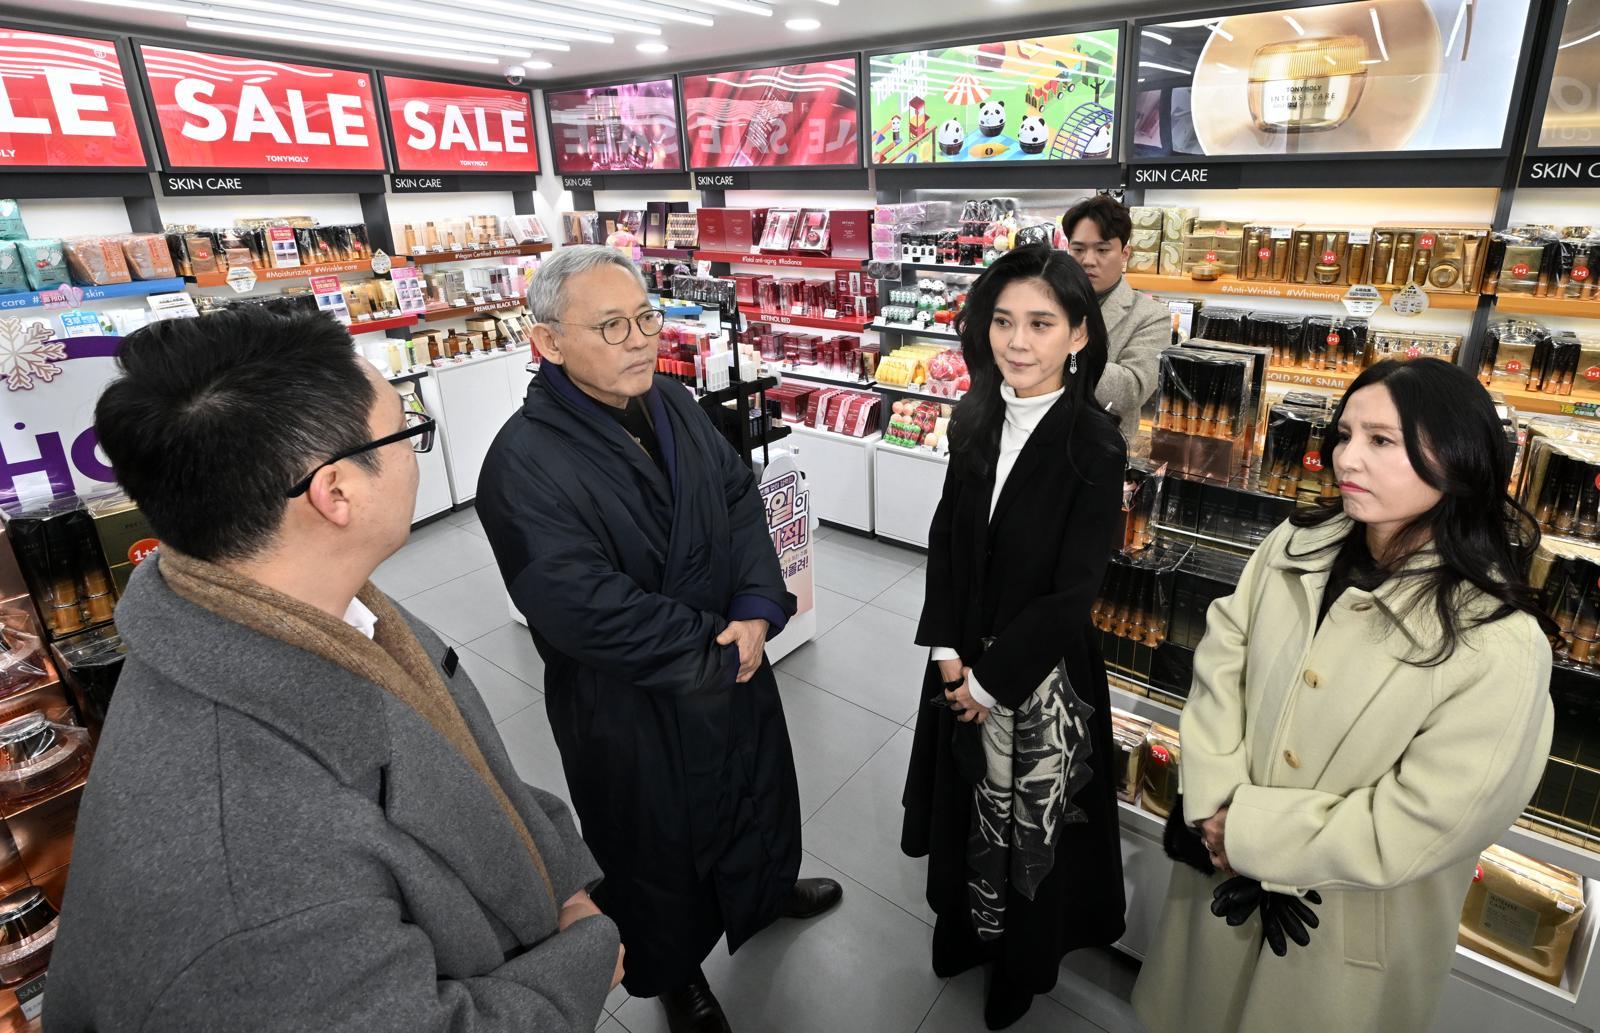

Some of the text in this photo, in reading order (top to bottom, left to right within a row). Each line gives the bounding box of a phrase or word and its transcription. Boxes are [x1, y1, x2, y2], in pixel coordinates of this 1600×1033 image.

[174, 78, 369, 147] SALE
[403, 101, 528, 153] SALE
[265, 155, 309, 163] TONYMOLY
[1135, 169, 1208, 182] SKIN CARE
[1530, 162, 1582, 178] SKIN
[168, 178, 243, 190] SKIN CARE
[395, 179, 442, 188] SKIN CARE
[564, 178, 592, 187] SKIN CARE
[697, 176, 734, 185] SKIN CARE
[755, 257, 776, 265] anti-aging
[266, 268, 312, 279] #Moisturizing
[315, 265, 343, 273] #Wrinkle
[1573, 269, 1587, 277] 1+1
[86, 289, 105, 299] skin
[1222, 285, 1281, 296] #Anti-Wrinkle
[1286, 288, 1341, 300] #Whitening
[1, 298, 26, 308] care
[474, 303, 496, 313] PREMIUM
[496, 301, 511, 310] BLACK
[760, 314, 791, 324] RETINOL RED
[1294, 375, 1313, 385] 24K
[1316, 377, 1345, 388] SNAIL
[764, 486, 808, 529] 일의
[1152, 750, 1168, 762] 2+1
